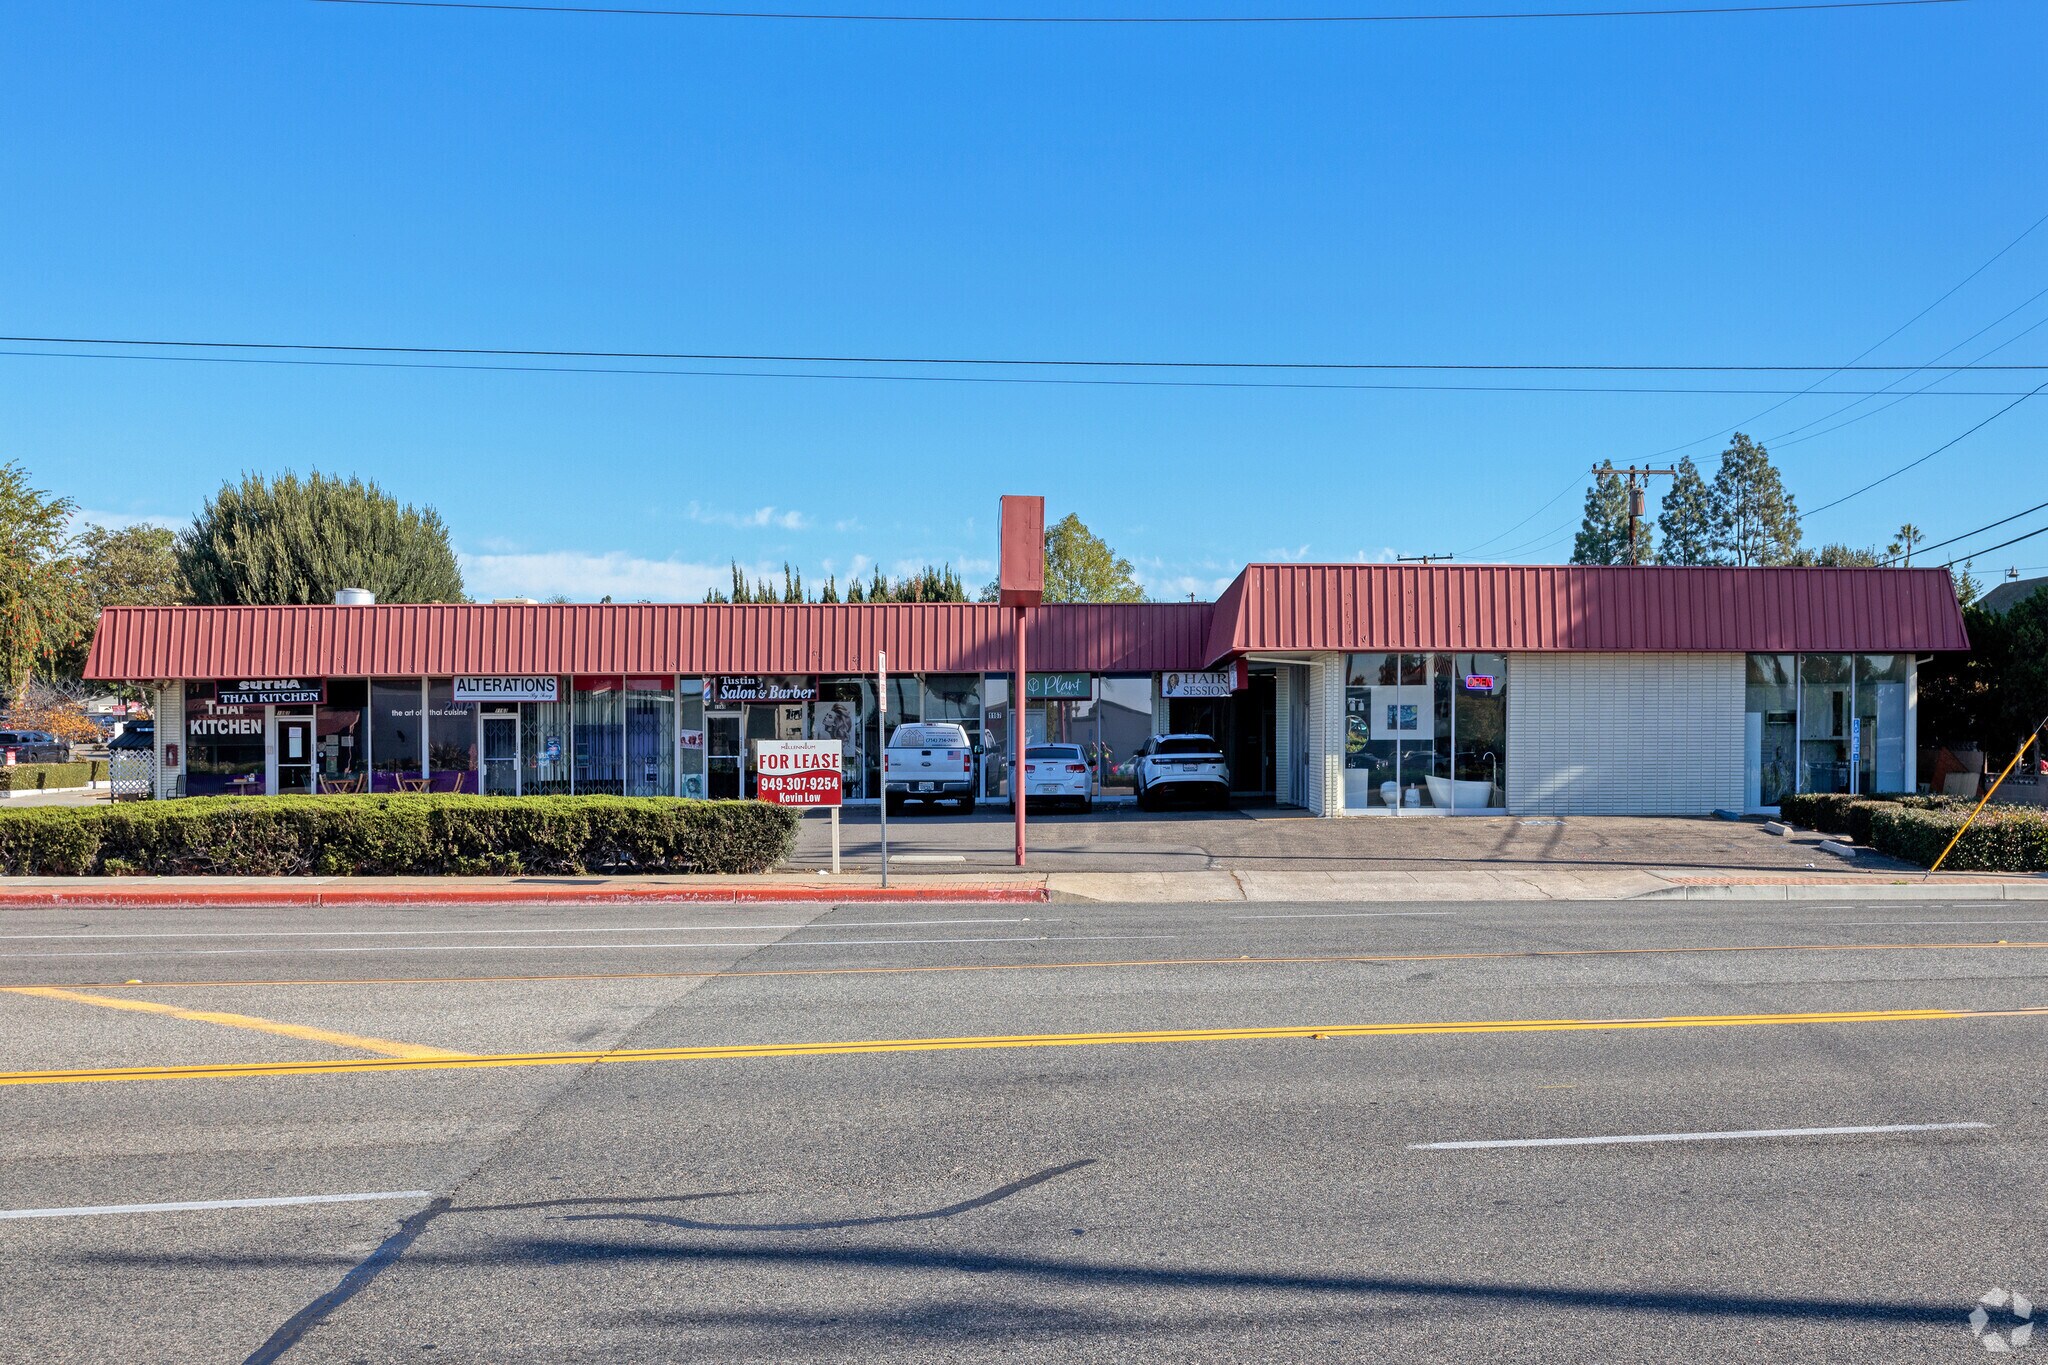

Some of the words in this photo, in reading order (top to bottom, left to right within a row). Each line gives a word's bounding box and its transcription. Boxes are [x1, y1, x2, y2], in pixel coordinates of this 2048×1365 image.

[721, 676, 755, 685] Tustin
[1184, 673, 1228, 684] HAIR
[1468, 677, 1493, 687] OPEN
[238, 679, 301, 690] SUTHA
[456, 678, 555, 692] ALTERATIONS
[1044, 675, 1082, 695] Plant
[720, 685, 756, 699] Salon
[758, 690, 767, 699] &
[768, 685, 815, 699] Barber
[1183, 685, 1229, 696] SESSION
[221, 694, 253, 703] THAI
[259, 692, 319, 703] KITCHEN
[443, 708, 468, 716] cuisine
[190, 719, 262, 735] KITCHEN
[759, 754, 789, 769] FOR
[794, 753, 840, 768] LEASE
[761, 777, 839, 791] 949-307-9254
[779, 792, 803, 803] Kevin
[804, 792, 821, 803] Low
